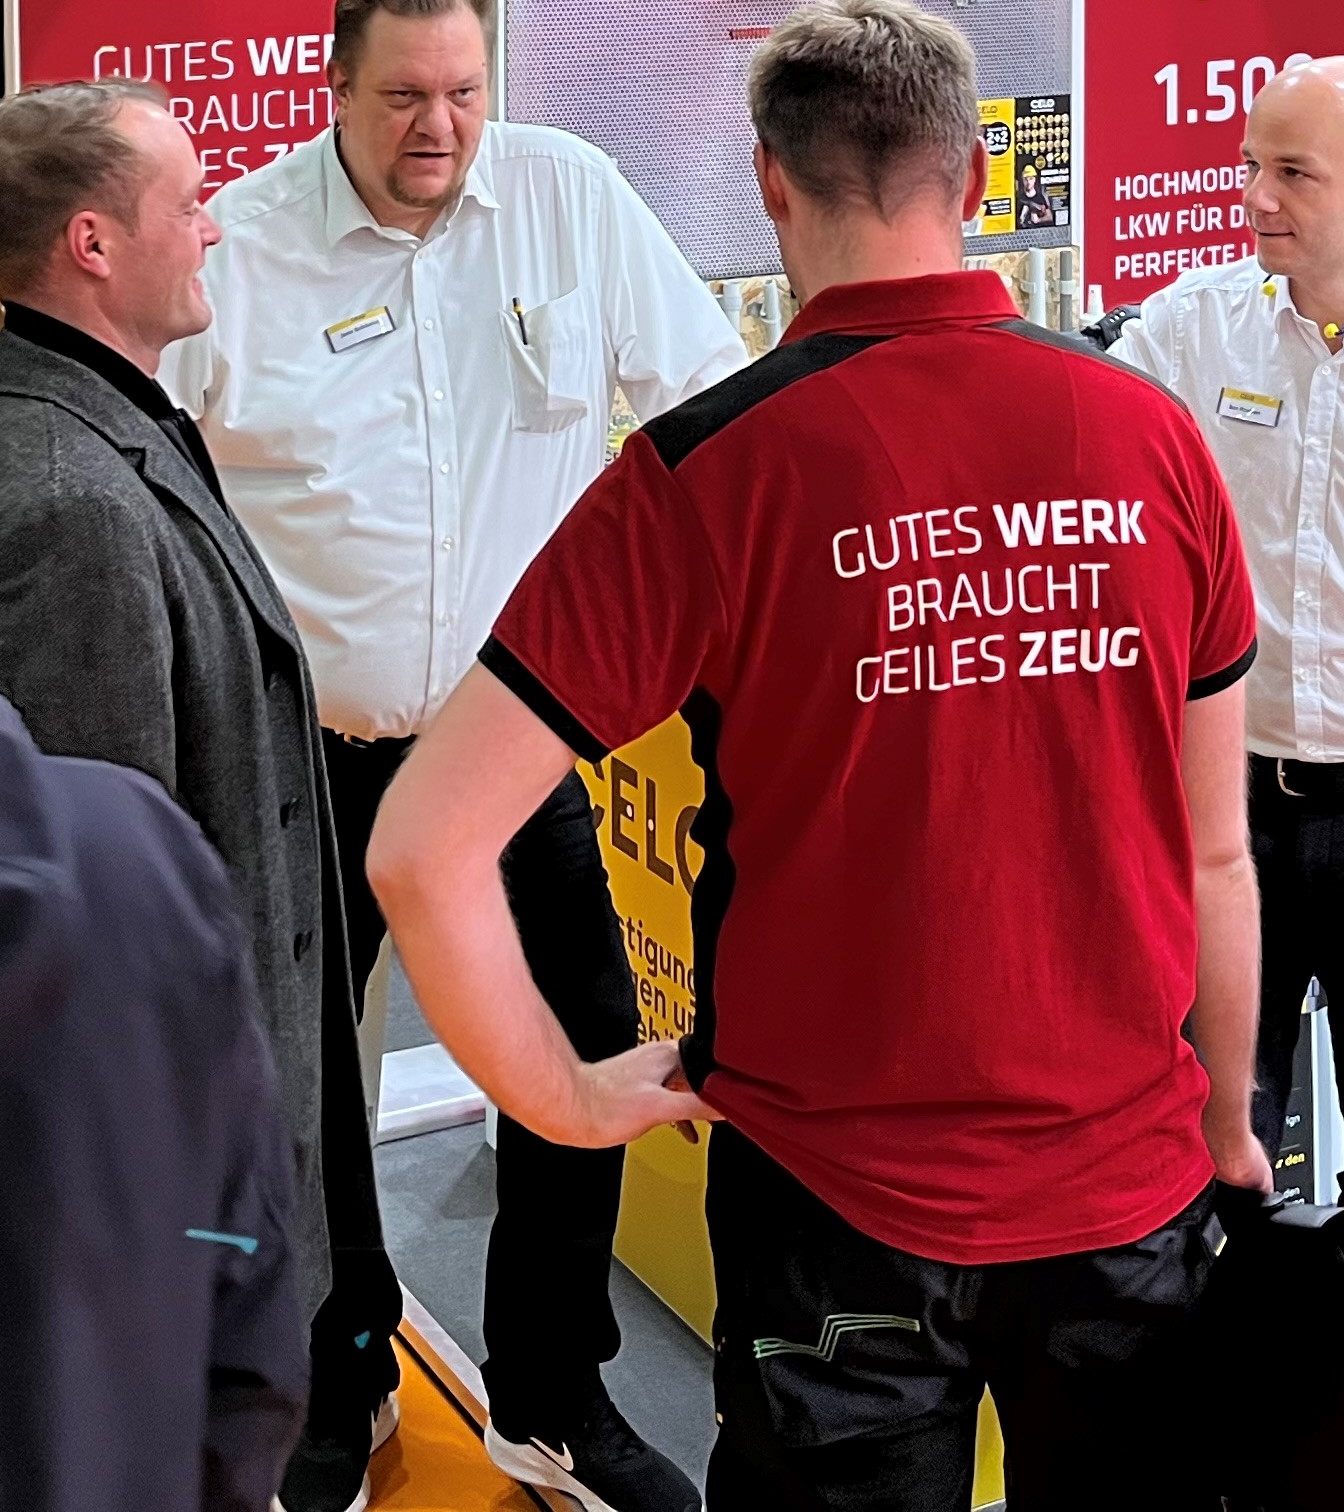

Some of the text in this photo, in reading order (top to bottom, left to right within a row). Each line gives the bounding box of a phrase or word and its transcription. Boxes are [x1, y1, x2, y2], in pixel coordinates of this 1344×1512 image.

[92, 39, 235, 83] GUTES
[169, 87, 334, 135] RAUCHT
[1114, 164, 1248, 202] HOCHMODE
[1115, 210, 1171, 241] LKW
[1176, 202, 1224, 235] FÜR
[1115, 243, 1236, 281] PERFEKTE
[832, 499, 1147, 579] GUTES WERK
[887, 562, 1111, 633] BRAUCHT
[856, 626, 1141, 704] GEILES ZEUG
